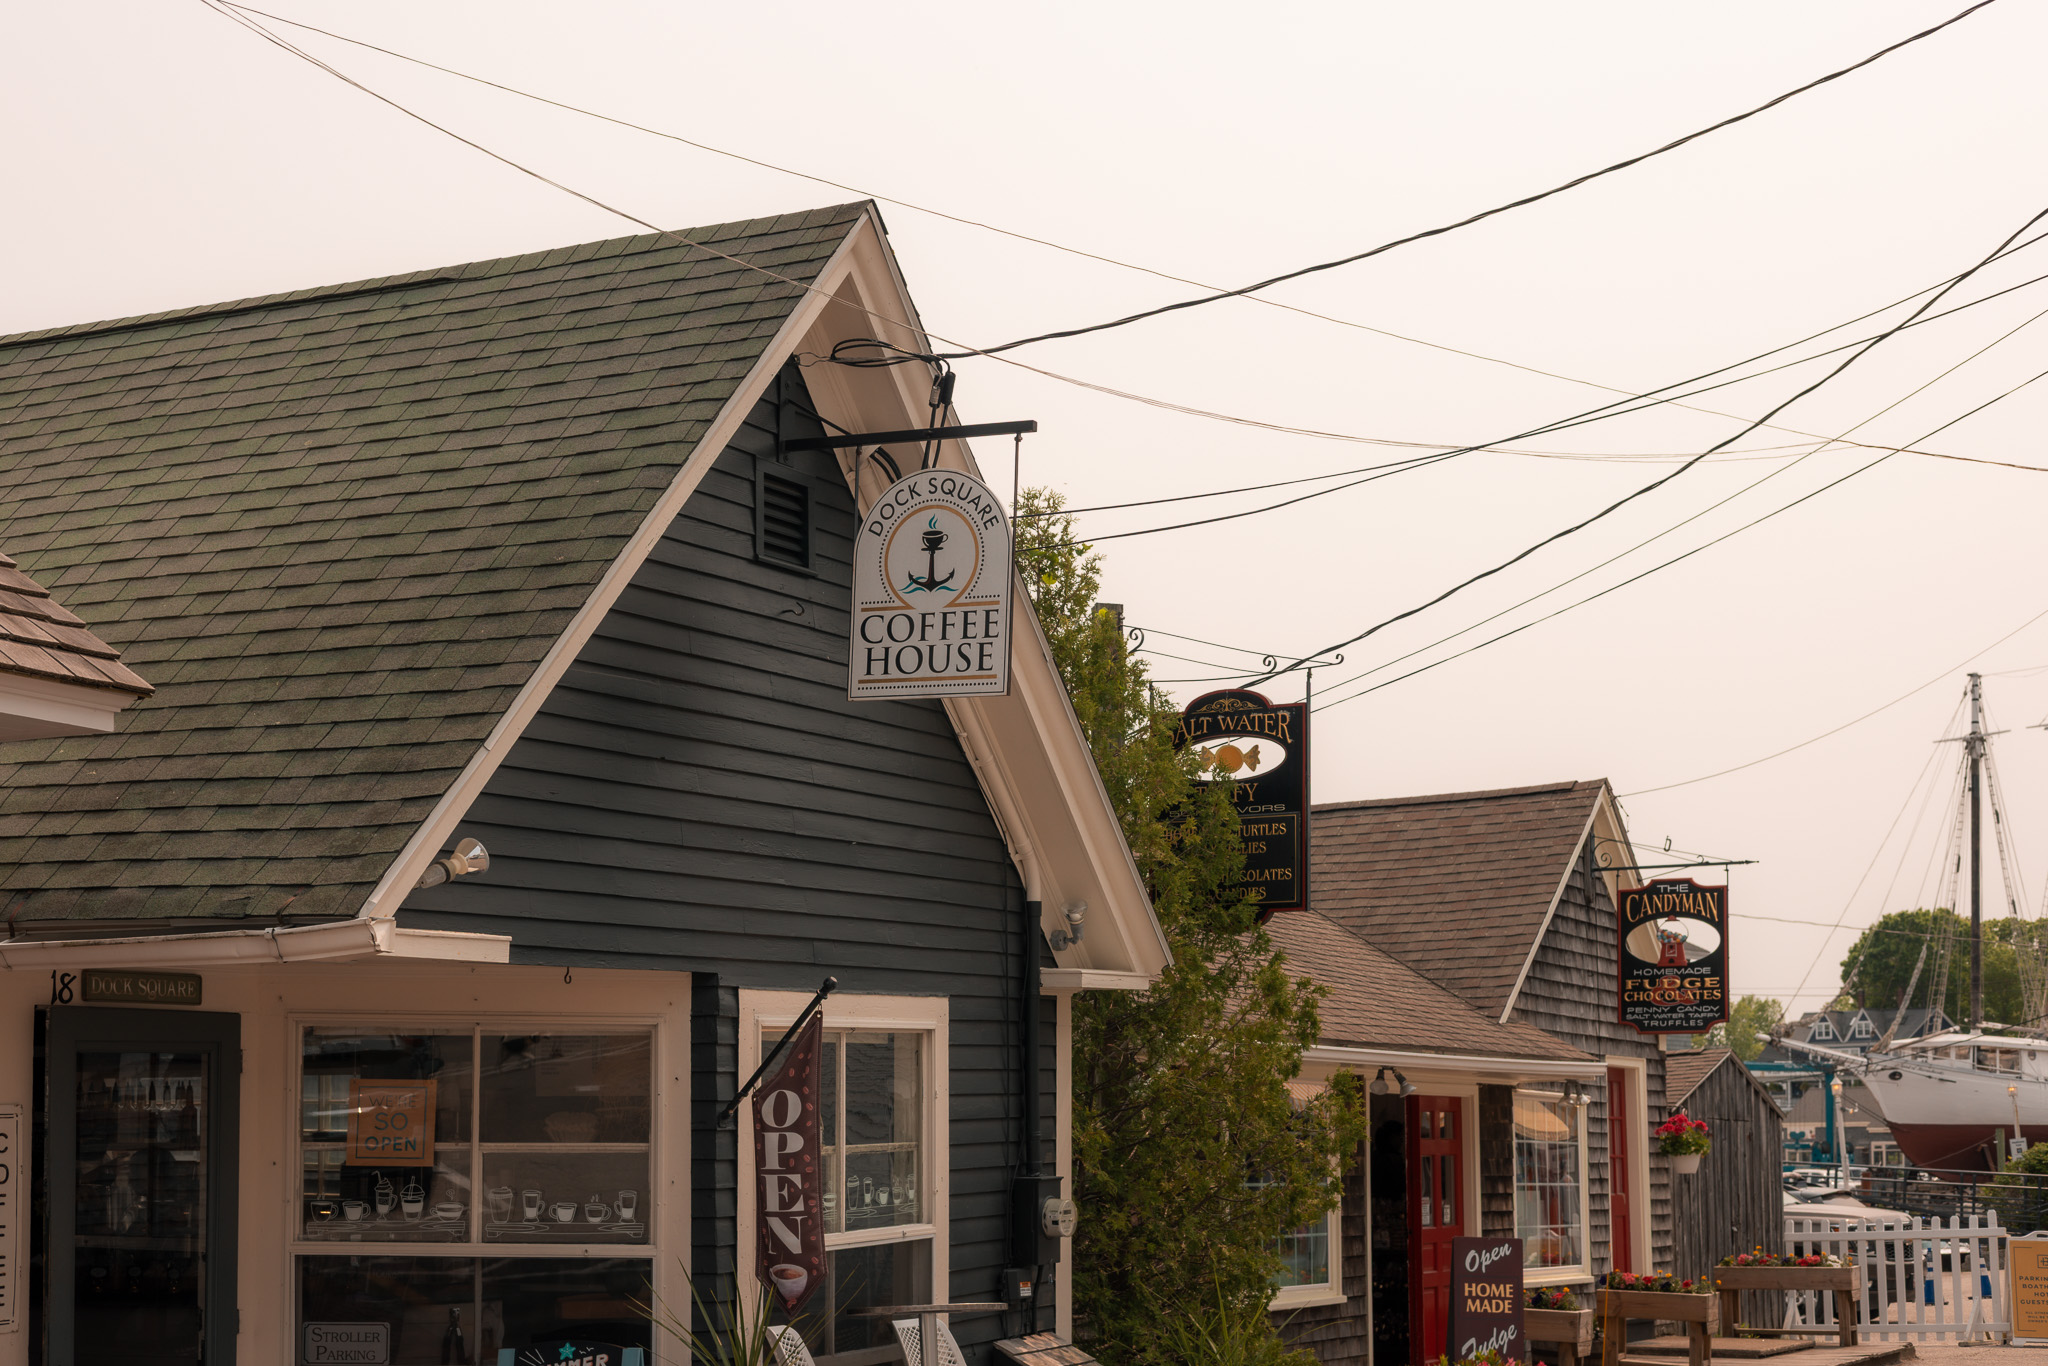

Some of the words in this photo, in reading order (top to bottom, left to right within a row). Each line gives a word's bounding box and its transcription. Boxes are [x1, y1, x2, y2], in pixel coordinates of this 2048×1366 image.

[868, 481, 922, 537] DOCK
[928, 477, 1000, 531] SQUARE
[860, 609, 1000, 644] COFFEE
[864, 642, 994, 676] HOUSE
[1171, 716, 1213, 745] ALT
[1217, 712, 1293, 744] WATER
[1656, 884, 1689, 893] THE
[1626, 892, 1719, 923] CANDYMAN
[1633, 967, 1711, 976] HOMEMADE
[51, 969, 77, 1005] 18
[91, 976, 134, 995] DOCK
[138, 978, 197, 1000] SQUARE
[1625, 977, 1720, 990] FUDGE
[1624, 989, 1722, 1002] CHOCOLATES
[1627, 1006, 1670, 1014] PENNY
[1676, 1005, 1720, 1013] CANDY
[1643, 1019, 1704, 1027] TRUFFLES
[369, 1095, 417, 1108] WE'RE
[374, 1112, 408, 1131] SO
[364, 1136, 417, 1151] OPEN
[761, 1089, 808, 1255] OPEN
[1465, 1243, 1512, 1274] Open
[1464, 1282, 1514, 1298] HOME
[1466, 1298, 1513, 1314] MADE
